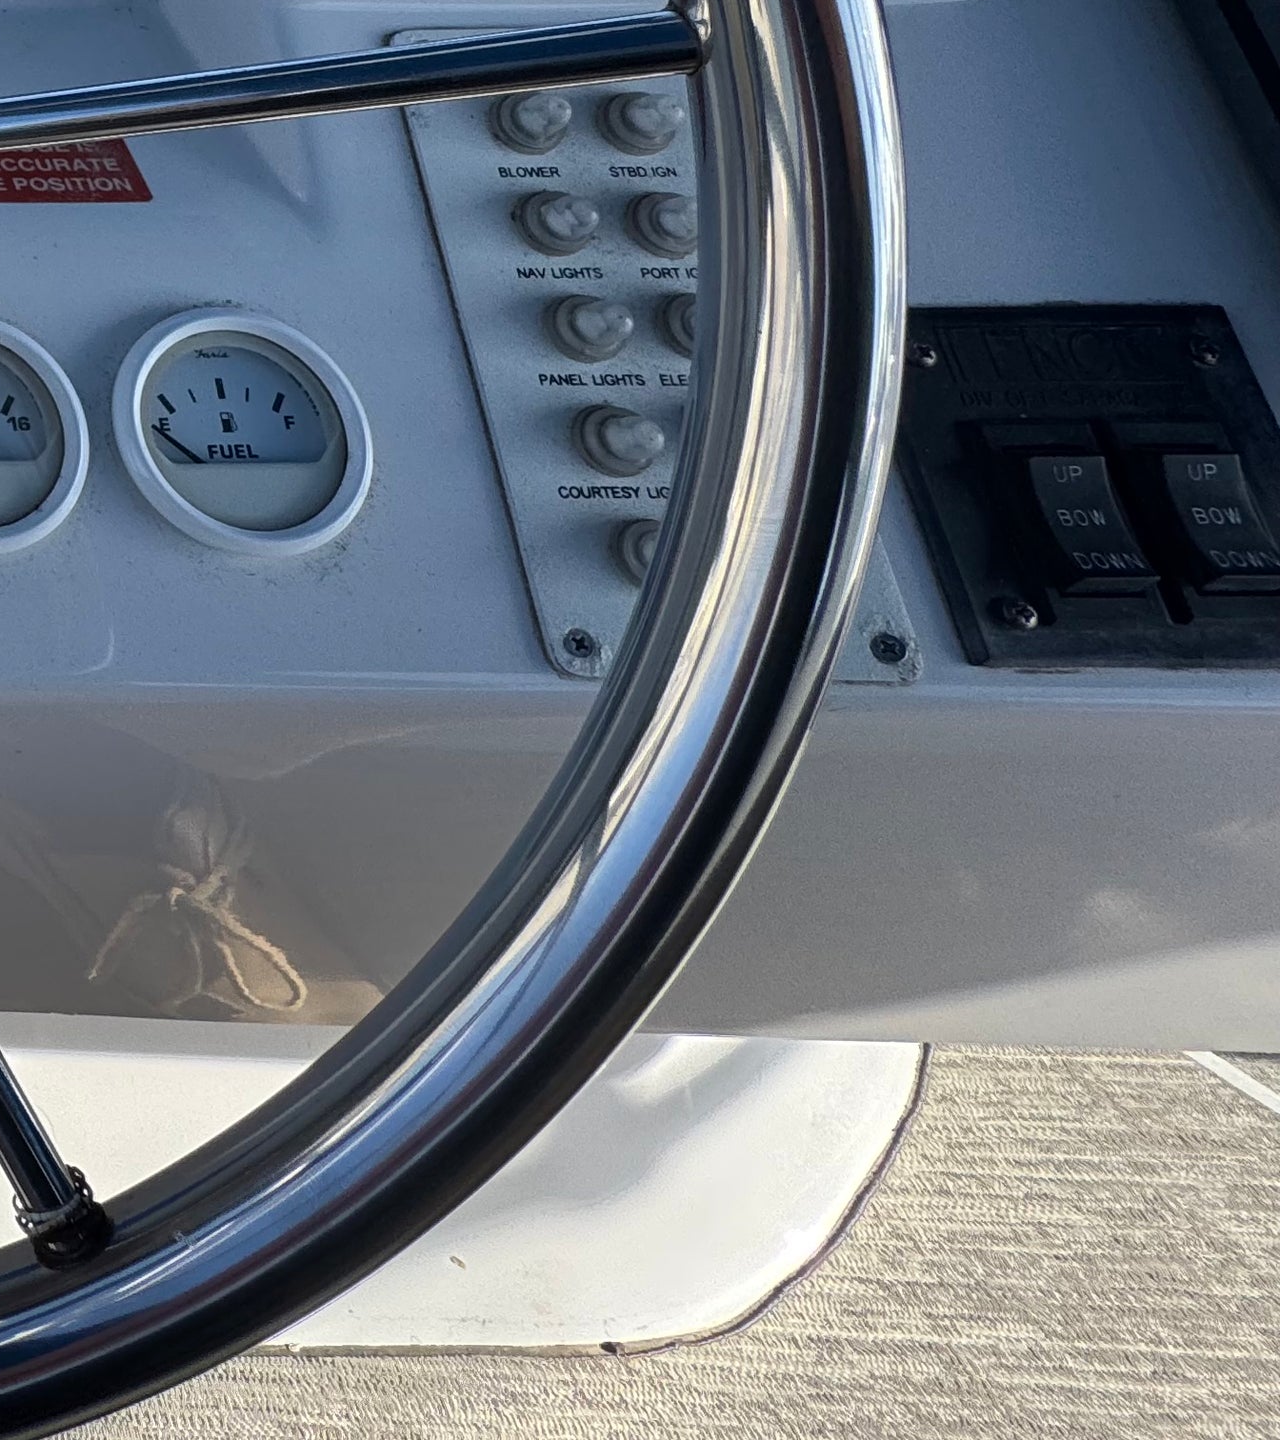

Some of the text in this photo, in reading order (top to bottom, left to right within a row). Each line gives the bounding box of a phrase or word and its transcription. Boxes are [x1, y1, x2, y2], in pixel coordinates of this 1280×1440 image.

[497, 166, 561, 179] BLOWER
[609, 166, 678, 179] STBD IGN
[14, 177, 133, 192] POSITION
[516, 267, 604, 281] NAV LIGHTS
[640, 267, 682, 280] PORT
[538, 374, 646, 388] PANEL LIGHTS
[7, 416, 31, 432] 16
[158, 416, 172, 433] E
[283, 415, 296, 431] F
[207, 444, 260, 460] FUEL
[1053, 464, 1083, 483] UP
[1187, 463, 1218, 481] UP
[558, 486, 640, 500] COURTESY
[1056, 509, 1107, 527] BOW
[1191, 507, 1242, 526] BOW
[1072, 551, 1146, 569] DOWN
